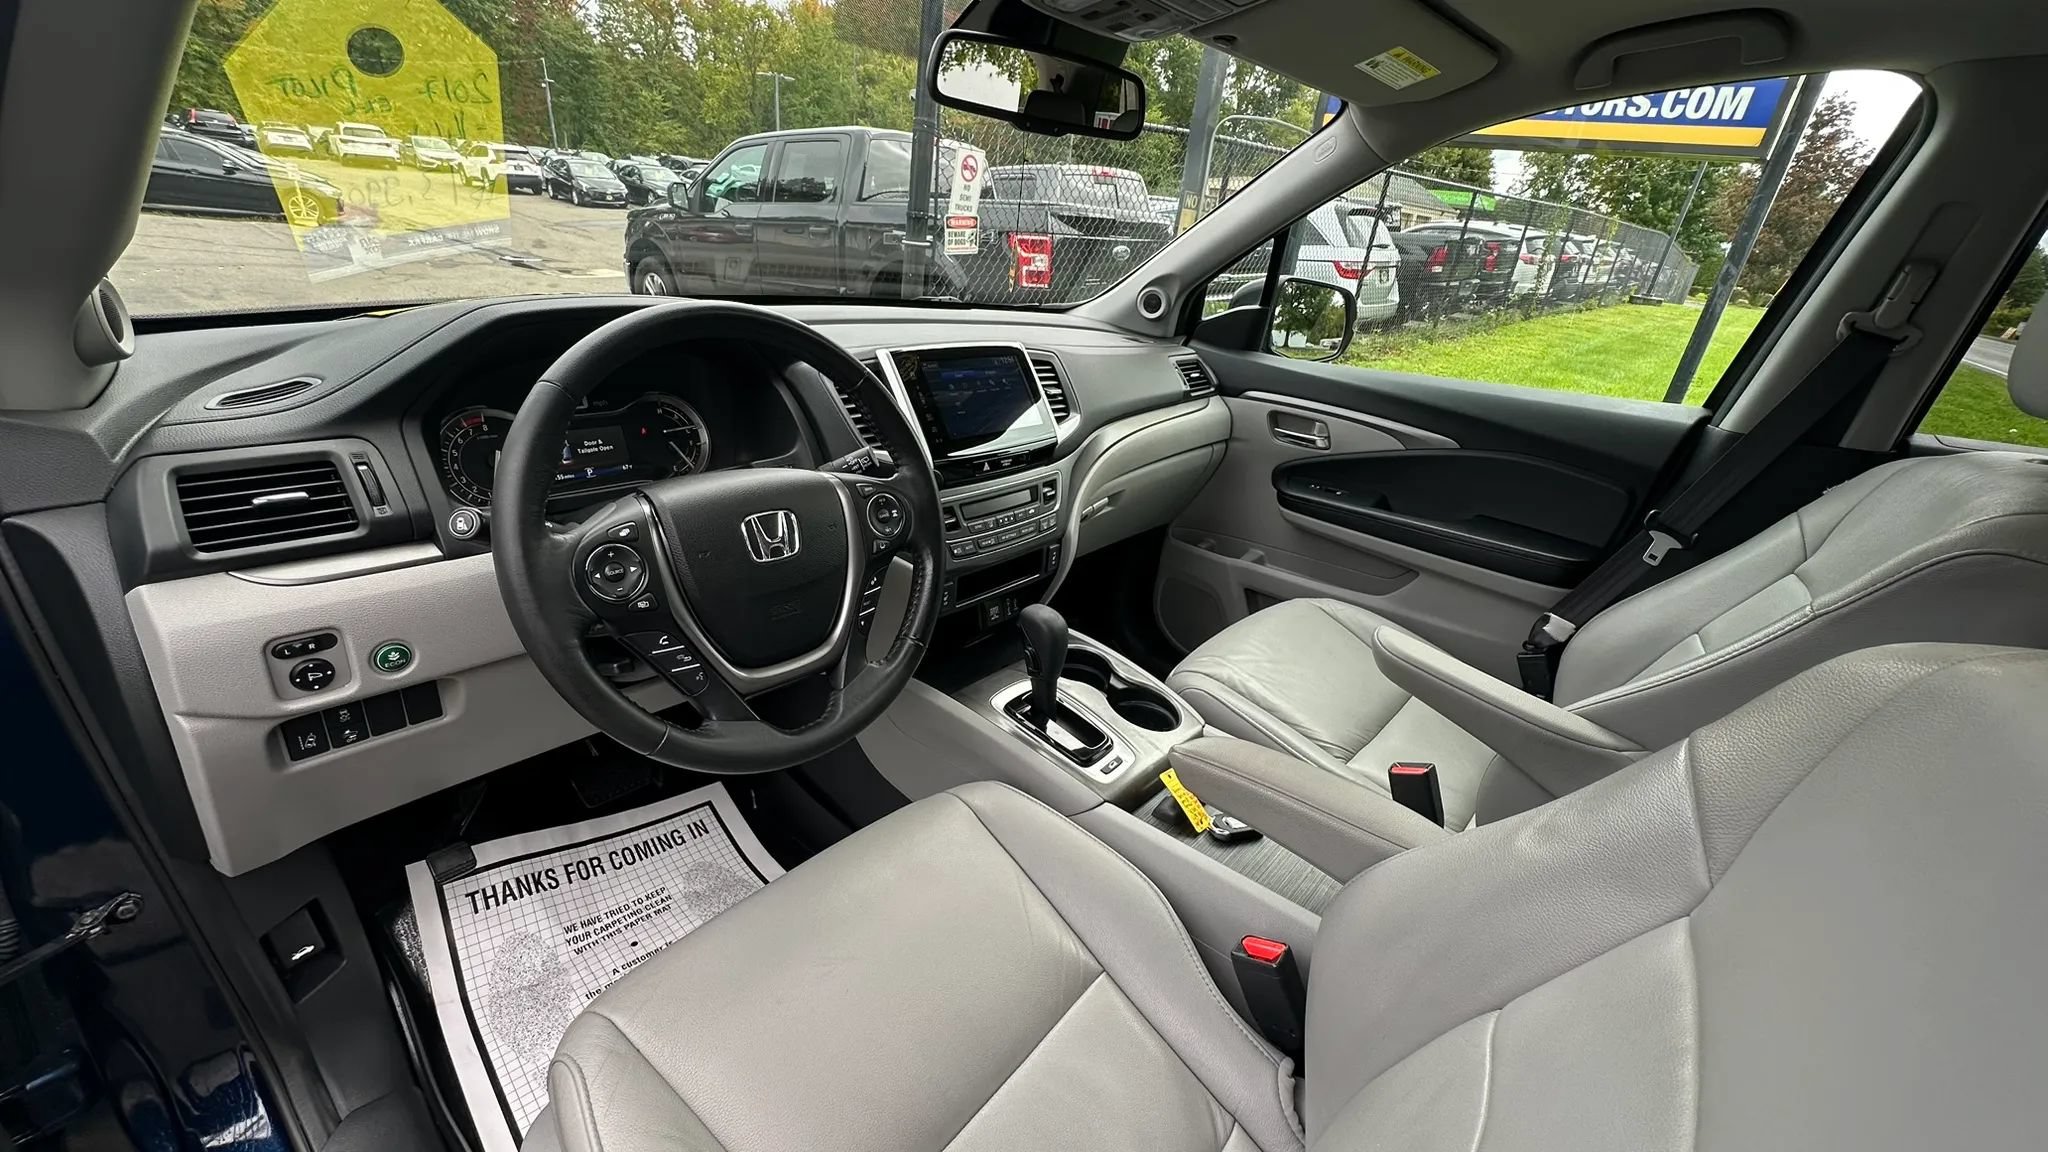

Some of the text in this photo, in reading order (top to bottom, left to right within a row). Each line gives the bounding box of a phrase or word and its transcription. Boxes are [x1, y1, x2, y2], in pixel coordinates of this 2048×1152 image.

[962, 184, 971, 192] NO
[959, 193, 972, 201] SEMI
[1185, 194, 1198, 209] NO
[955, 204, 973, 212] TRUCKS
[577, 446, 598, 454] Tailgate
[607, 568, 624, 576] SOURCE
[384, 658, 406, 668] ECON
[464, 818, 710, 915] THANKS FOR COMING IN
[563, 886, 666, 935] WE HAVE TRIED TO KEEP
[565, 894, 673, 946] YOUR CARPETING CLEAN
[574, 904, 672, 955] WITH THIS PAPER MAT
[612, 967, 620, 975] A
[621, 946, 663, 970] customer
[585, 988, 602, 1000] the
